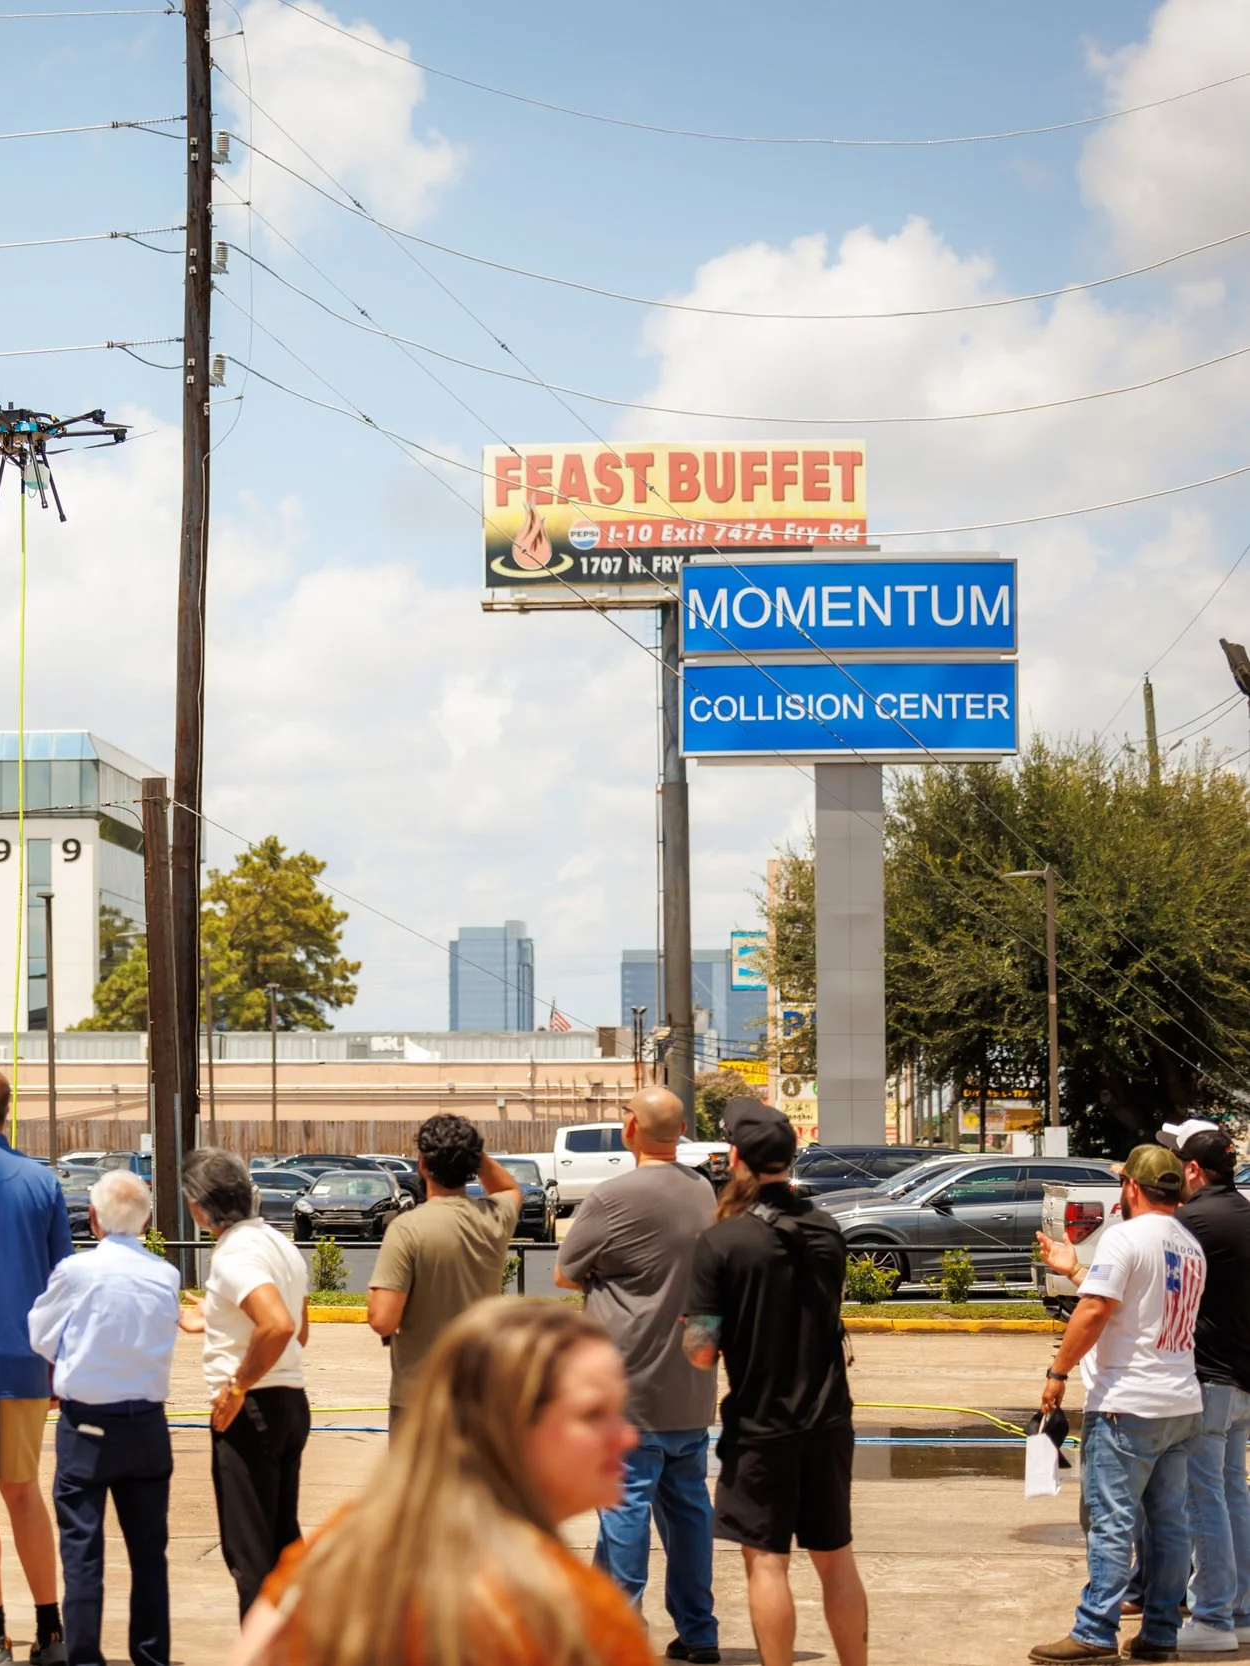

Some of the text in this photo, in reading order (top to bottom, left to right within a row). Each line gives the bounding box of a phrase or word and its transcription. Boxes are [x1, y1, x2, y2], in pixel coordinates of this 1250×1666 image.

[495, 451, 862, 507] FEAST BUFFET
[570, 530, 599, 538] PEPSI
[608, 522, 860, 544] I-10 Exit 747A Fry Rd
[580, 555, 682, 575] 1707 N. FRY
[688, 584, 1010, 630] MOMENTUM
[690, 692, 1010, 722] COLLISION CENTER
[1162, 1239, 1202, 1257] FREDOM
